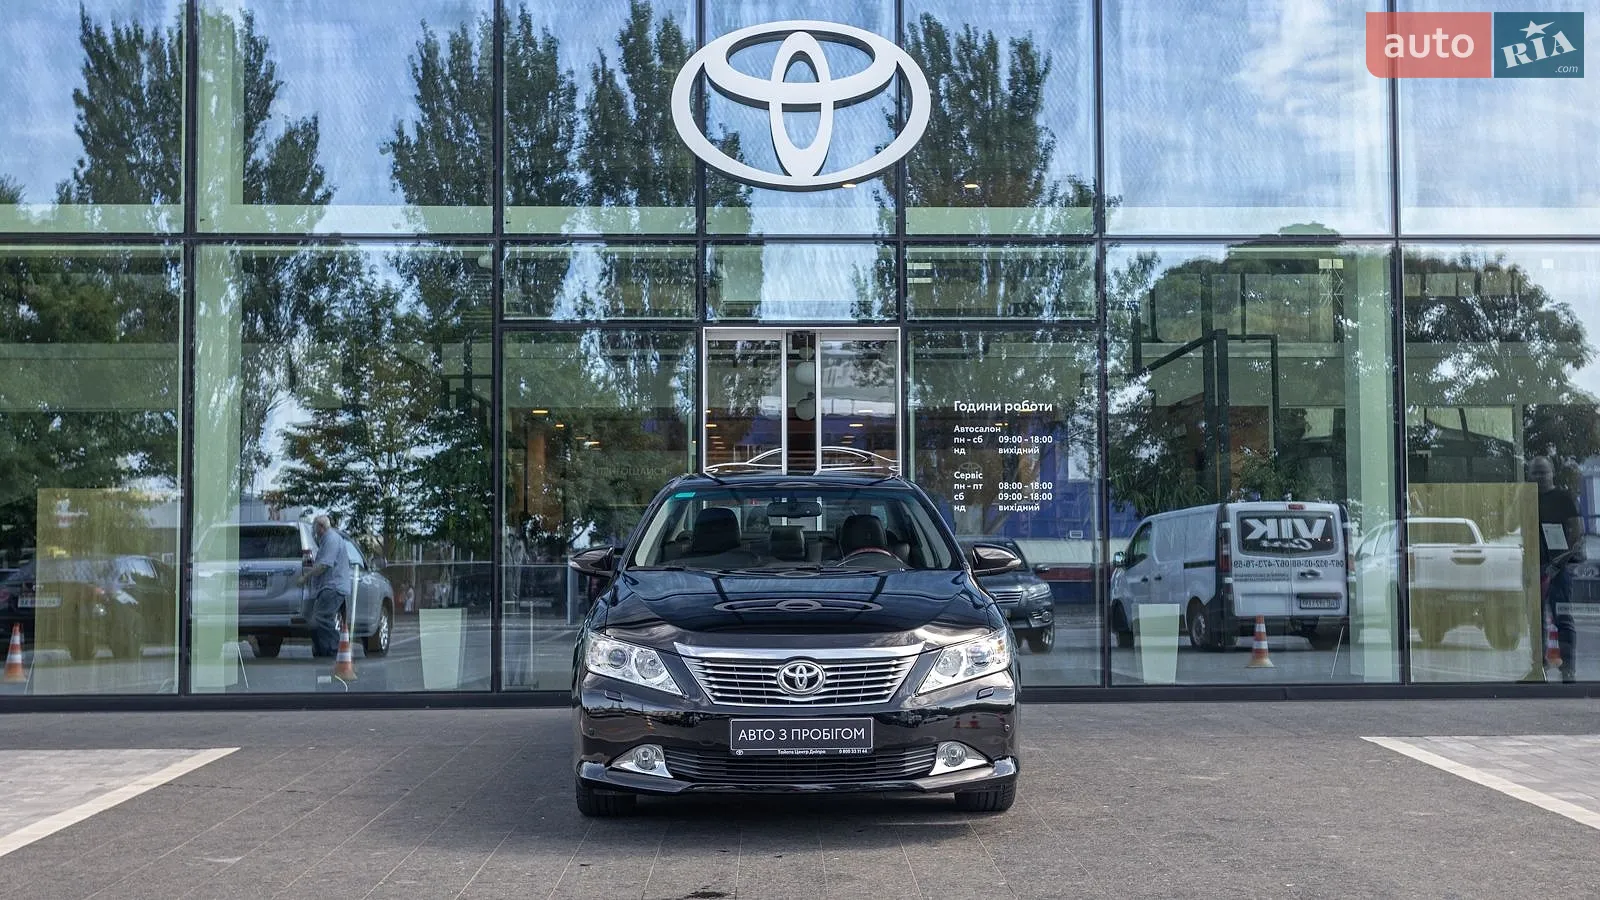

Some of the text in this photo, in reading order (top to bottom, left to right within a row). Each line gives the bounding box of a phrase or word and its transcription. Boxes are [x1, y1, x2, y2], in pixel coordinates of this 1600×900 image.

[954, 400, 1053, 414] Години роботи
[953, 425, 1001, 433] Автосалон
[972, 435, 983, 443] сб
[998, 435, 1022, 443] 09:00
[1030, 435, 1053, 443] 18:00
[998, 446, 1040, 455] вихідний
[953, 471, 983, 480] Сервіс
[998, 482, 1022, 490] 08:00
[1030, 482, 1053, 490] 18:00
[953, 492, 965, 500] сб
[998, 492, 1022, 501] 09:00
[1030, 492, 1053, 501] 18:00
[998, 503, 1040, 512] вихідний
[738, 728, 775, 741] АВТО
[791, 727, 865, 741] ПРОБІГОМ
